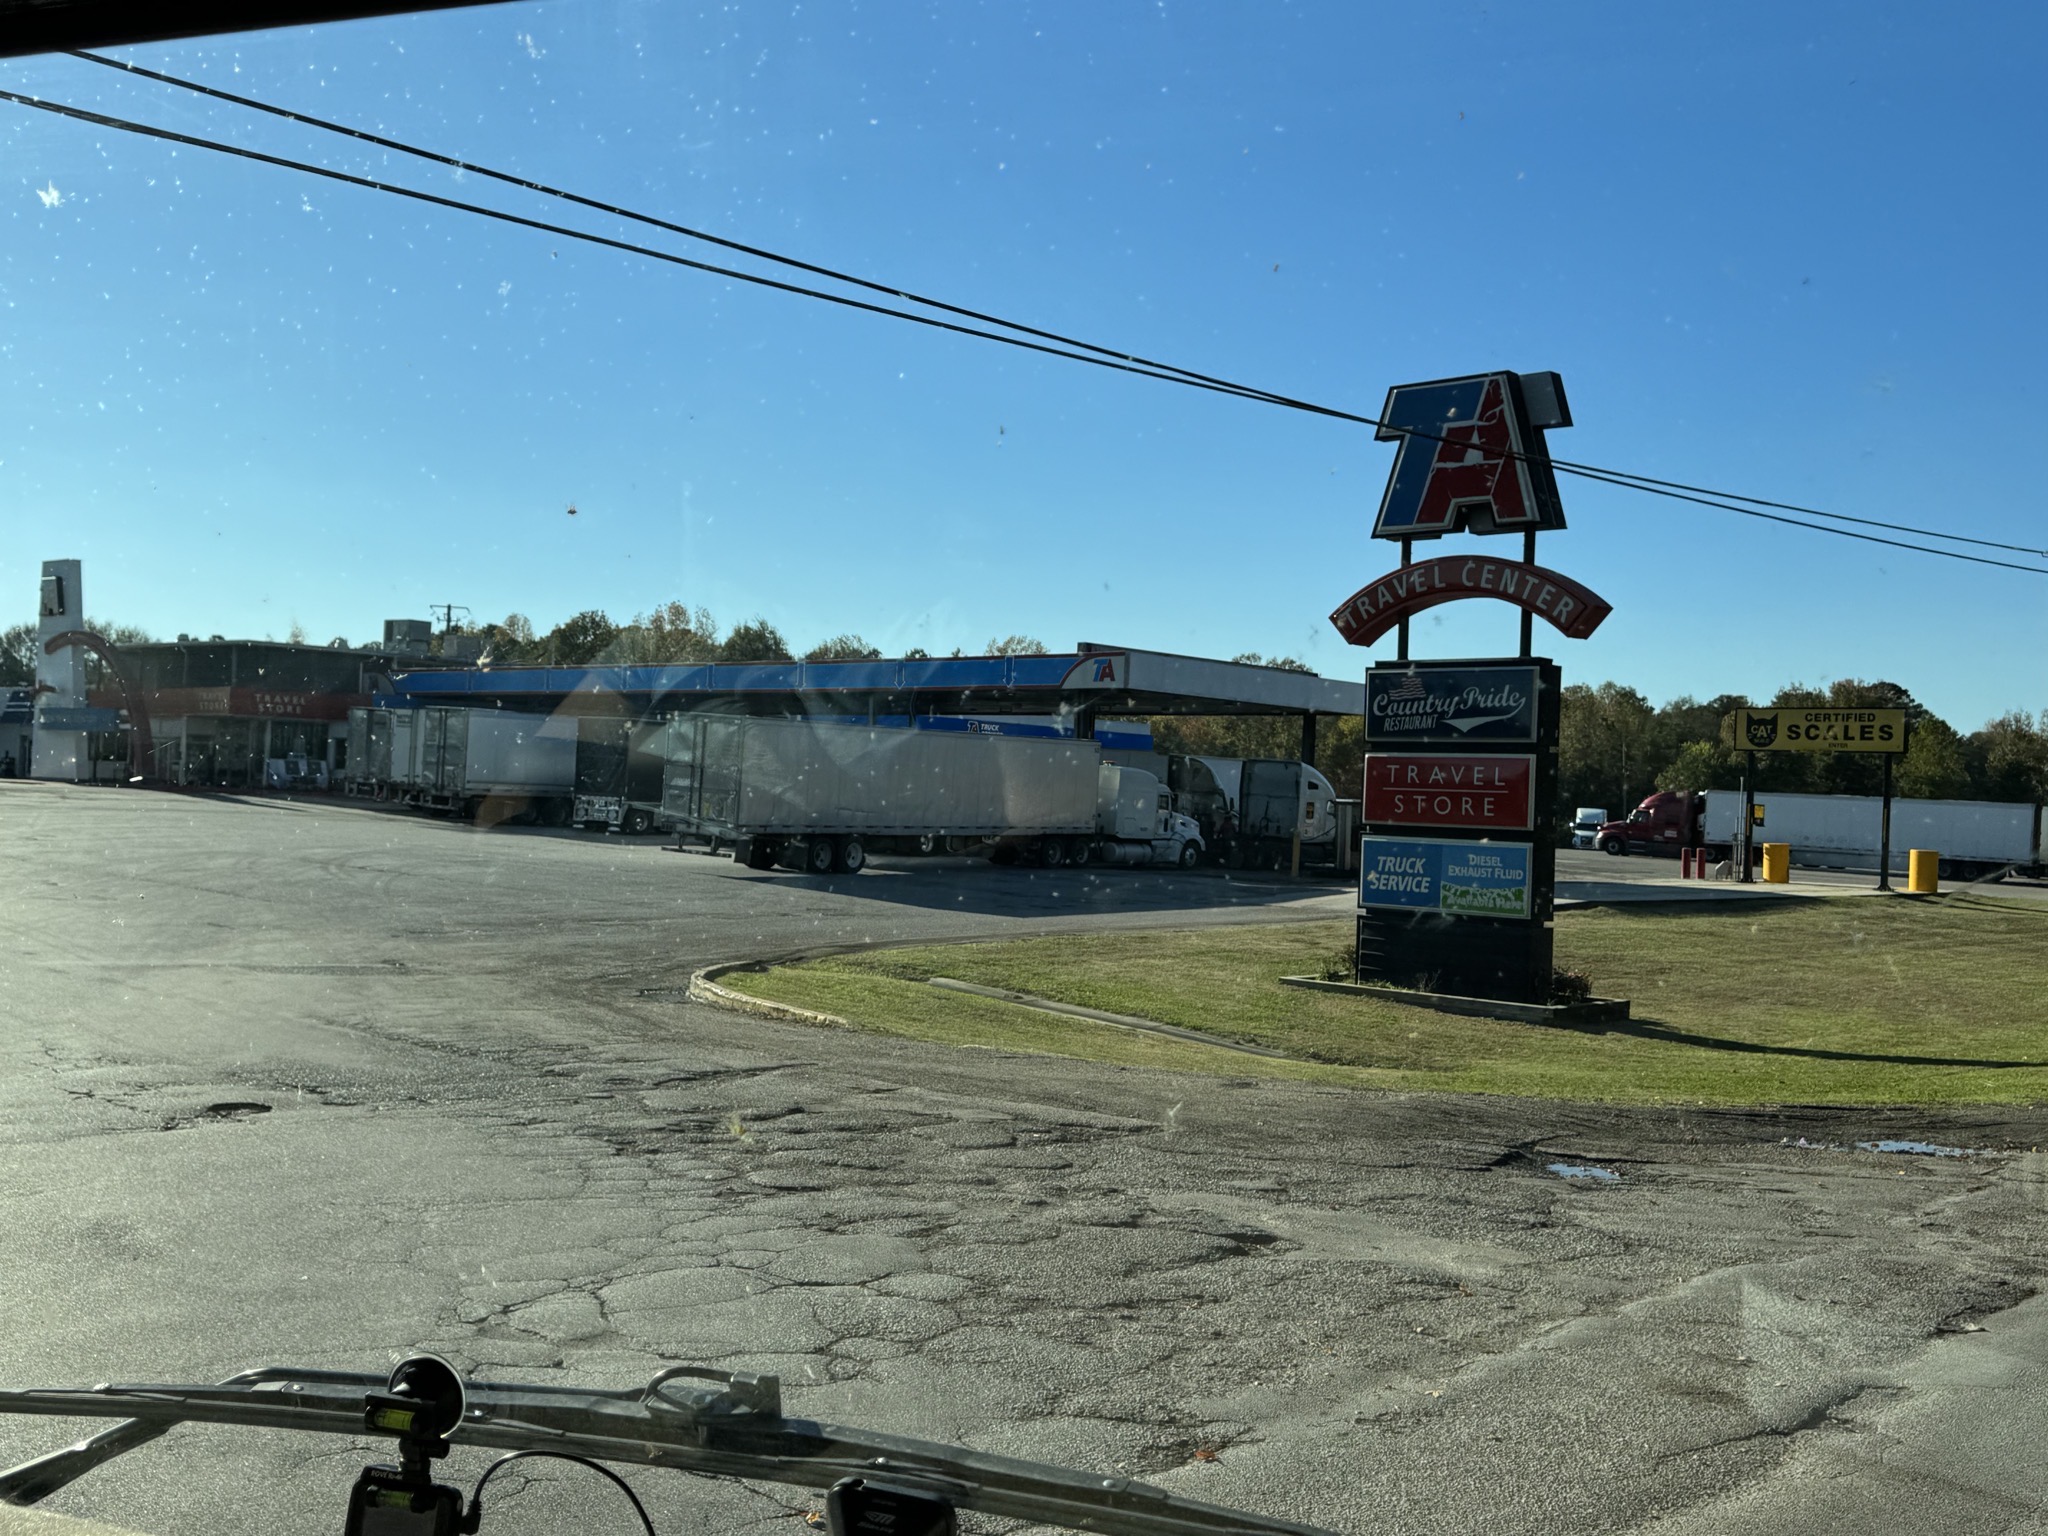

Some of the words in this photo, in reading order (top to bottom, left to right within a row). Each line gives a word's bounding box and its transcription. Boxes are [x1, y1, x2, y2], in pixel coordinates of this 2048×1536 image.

[1341, 565, 1446, 630] TRAVEL
[1461, 561, 1576, 624] CENTER
[1092, 658, 1115, 683] TA
[1373, 693, 1459, 719] Country
[1459, 684, 1523, 710] Pride
[1384, 714, 1439, 732] RESTAURANT
[1804, 712, 1877, 723] CERTIFIED
[981, 723, 1000, 732] TRUCK
[1750, 725, 1774, 738] CAT
[1786, 724, 1895, 742] SCALES
[1386, 764, 1506, 787] TRAVEL
[1394, 794, 1495, 817] STORE
[1377, 856, 1427, 875] TRUCK
[1468, 854, 1503, 867] DIESEL
[1448, 864, 1493, 879] EXHAUST
[1494, 867, 1524, 880] FLUID
[1370, 874, 1431, 894] SERVICE
